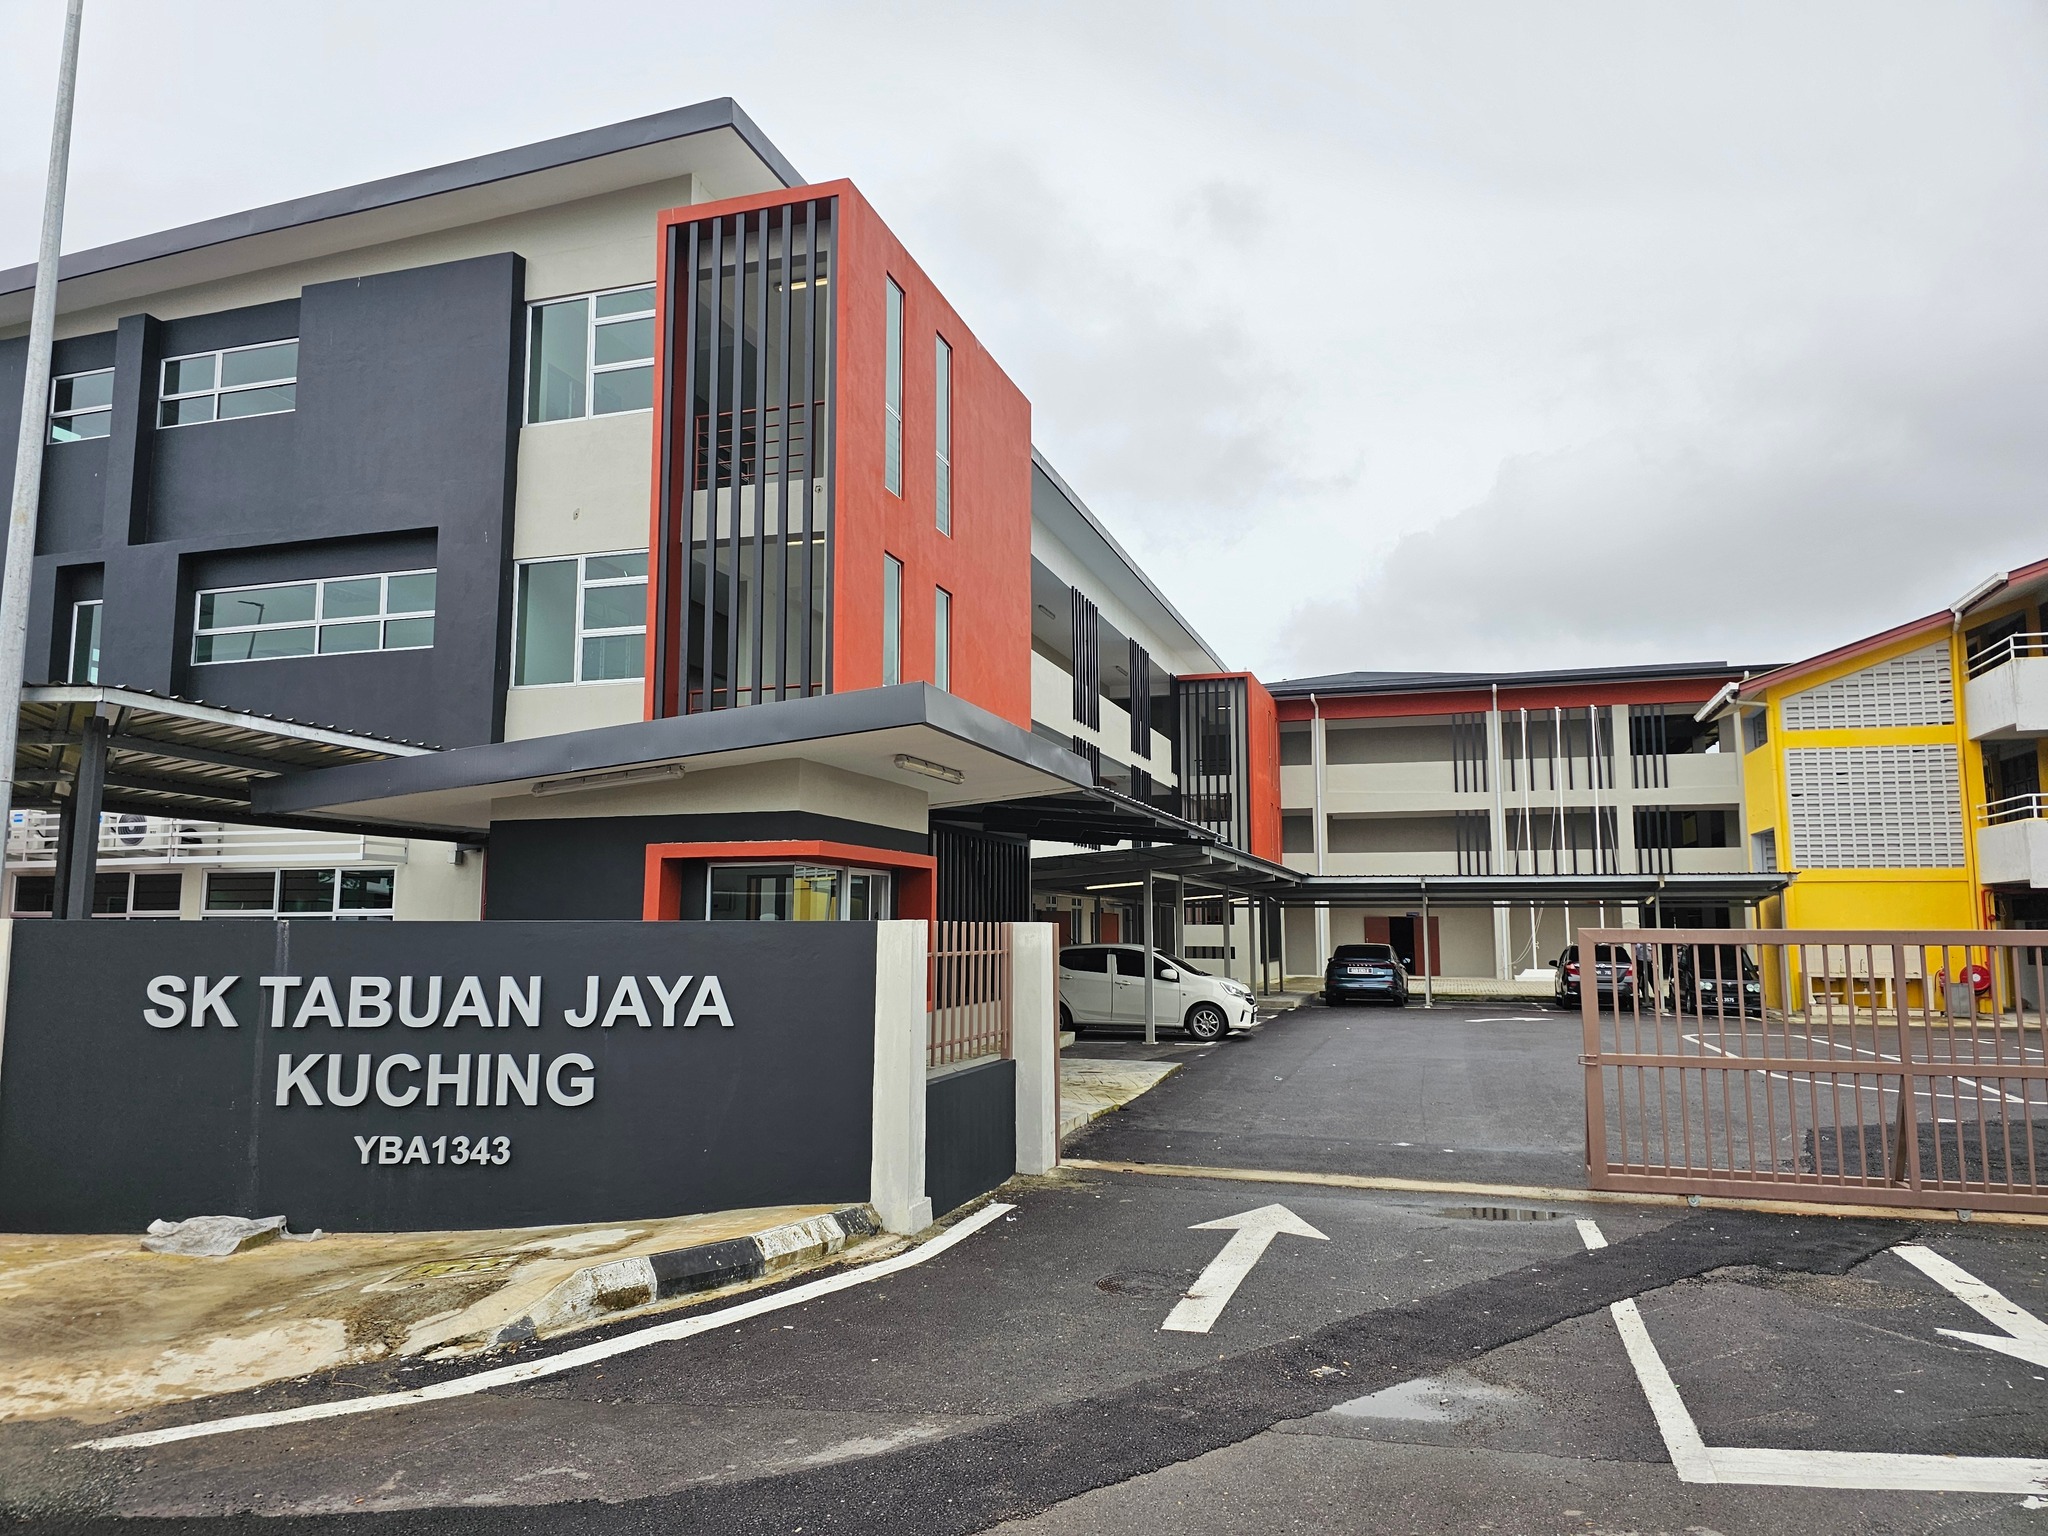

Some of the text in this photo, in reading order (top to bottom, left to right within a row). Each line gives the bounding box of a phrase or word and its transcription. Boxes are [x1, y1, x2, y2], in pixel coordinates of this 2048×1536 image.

[142, 975, 735, 1029] SK TABUAN JAYA
[275, 1053, 596, 1108] KUCHING
[353, 1135, 511, 1166] YBA1343
